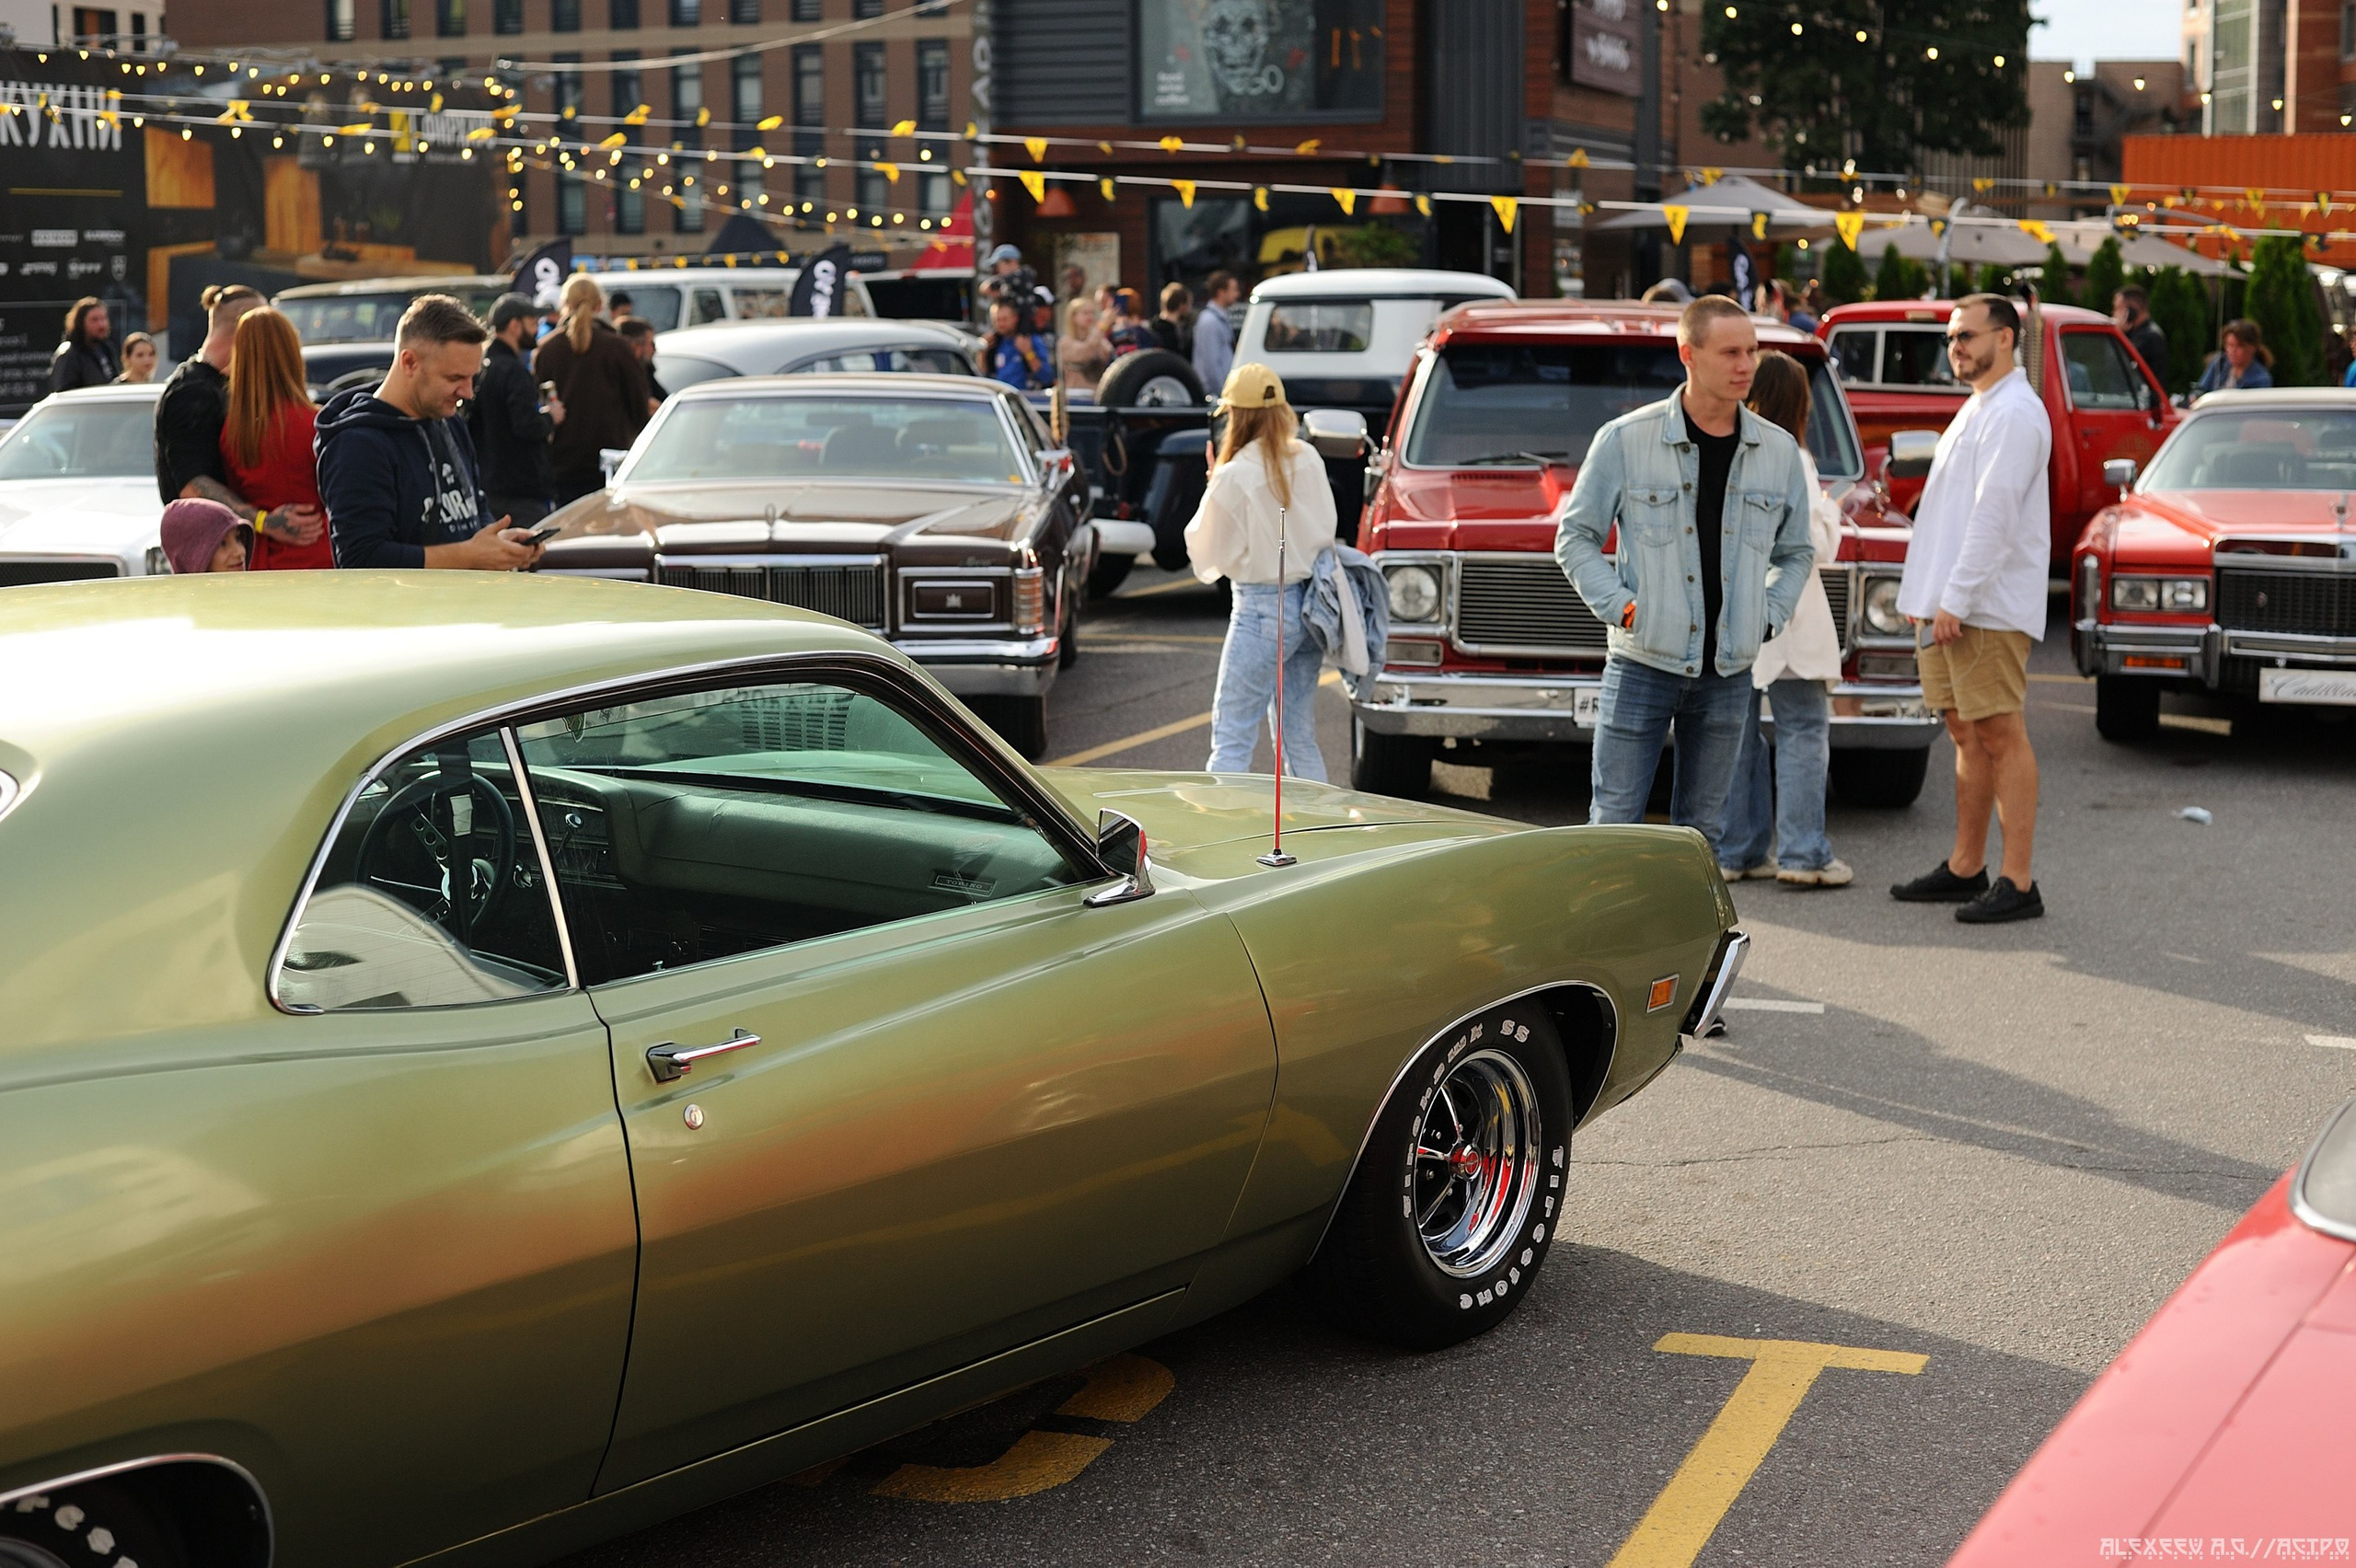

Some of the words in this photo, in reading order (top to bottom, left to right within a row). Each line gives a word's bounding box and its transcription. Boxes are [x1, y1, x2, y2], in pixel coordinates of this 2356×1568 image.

[946, 879, 983, 889] TORINO
[1499, 1019, 1530, 1044] SS
[1460, 1146, 1565, 1309] Firestone
